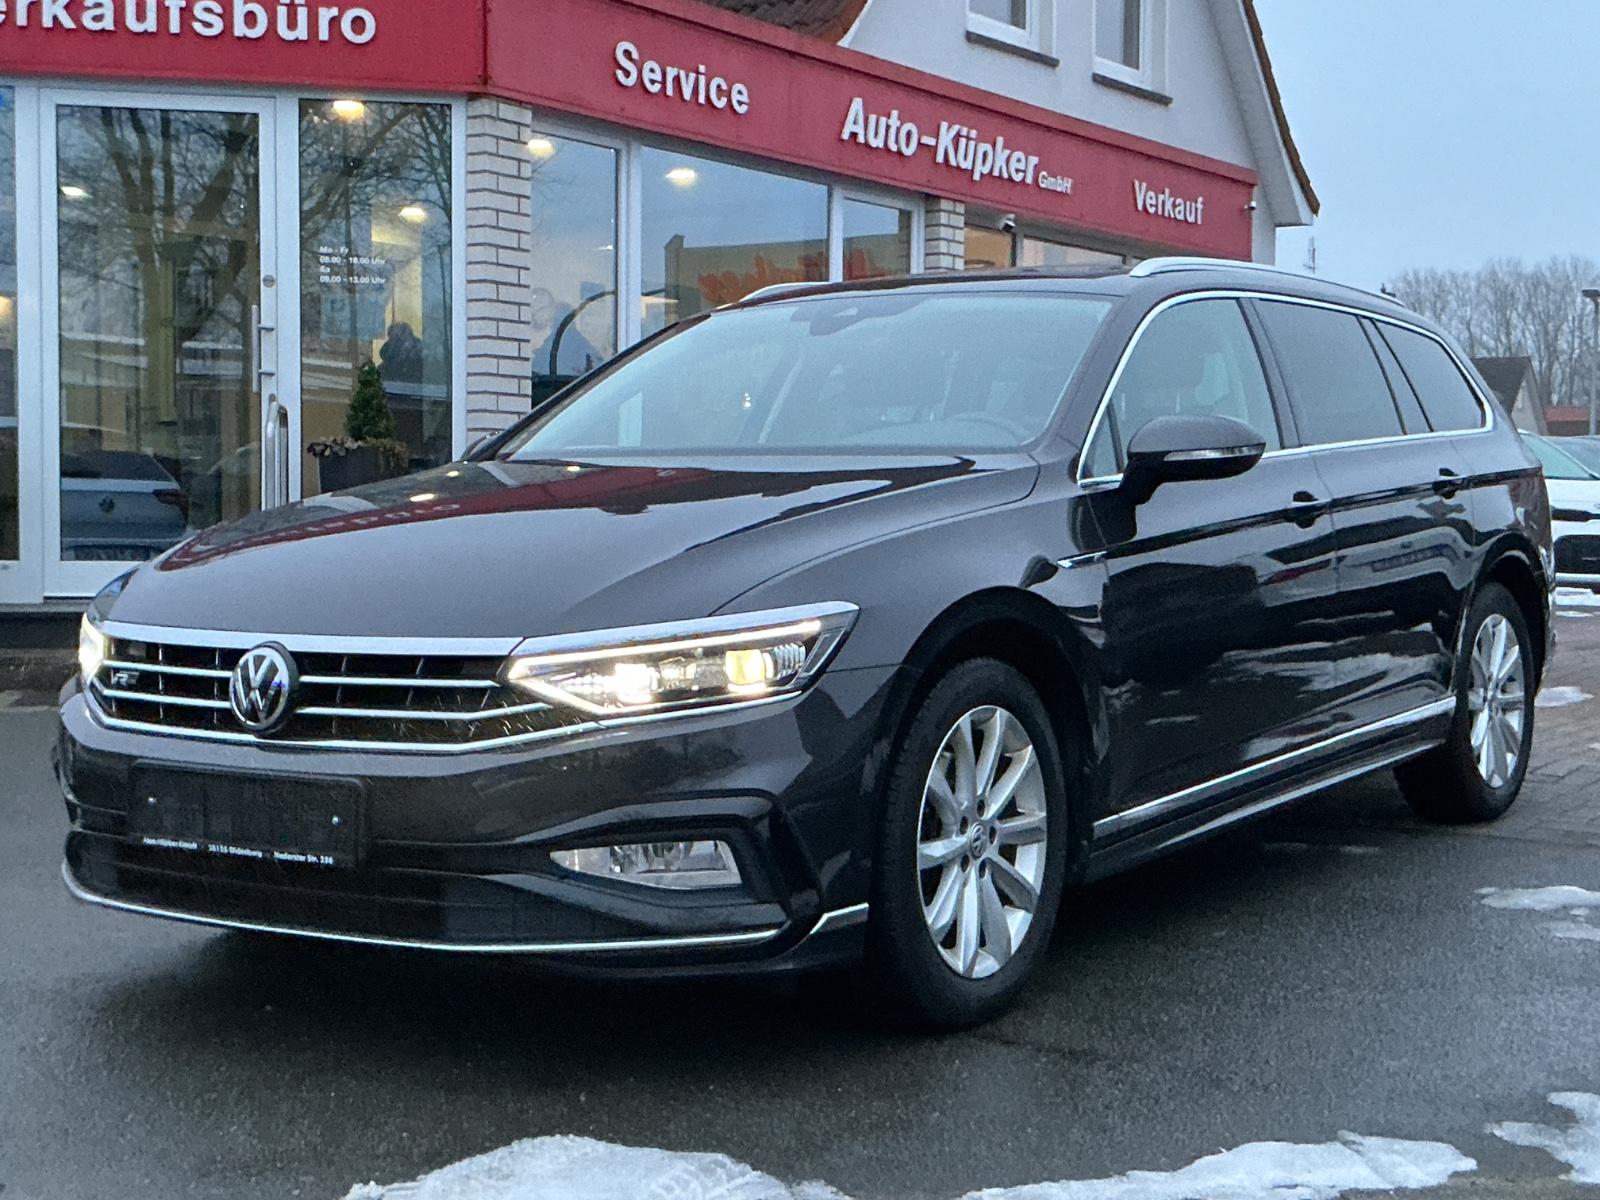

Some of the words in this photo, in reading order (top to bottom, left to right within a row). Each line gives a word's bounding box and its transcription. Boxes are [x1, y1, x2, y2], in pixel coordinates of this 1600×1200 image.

[0, 0, 376, 44] rkaufsbüro
[614, 41, 749, 114] Service
[840, 97, 1039, 184] Auto-Küpker
[1134, 179, 1203, 225] Verkauf
[319, 246, 333, 254] Mo
[371, 276, 387, 284] Uhr
